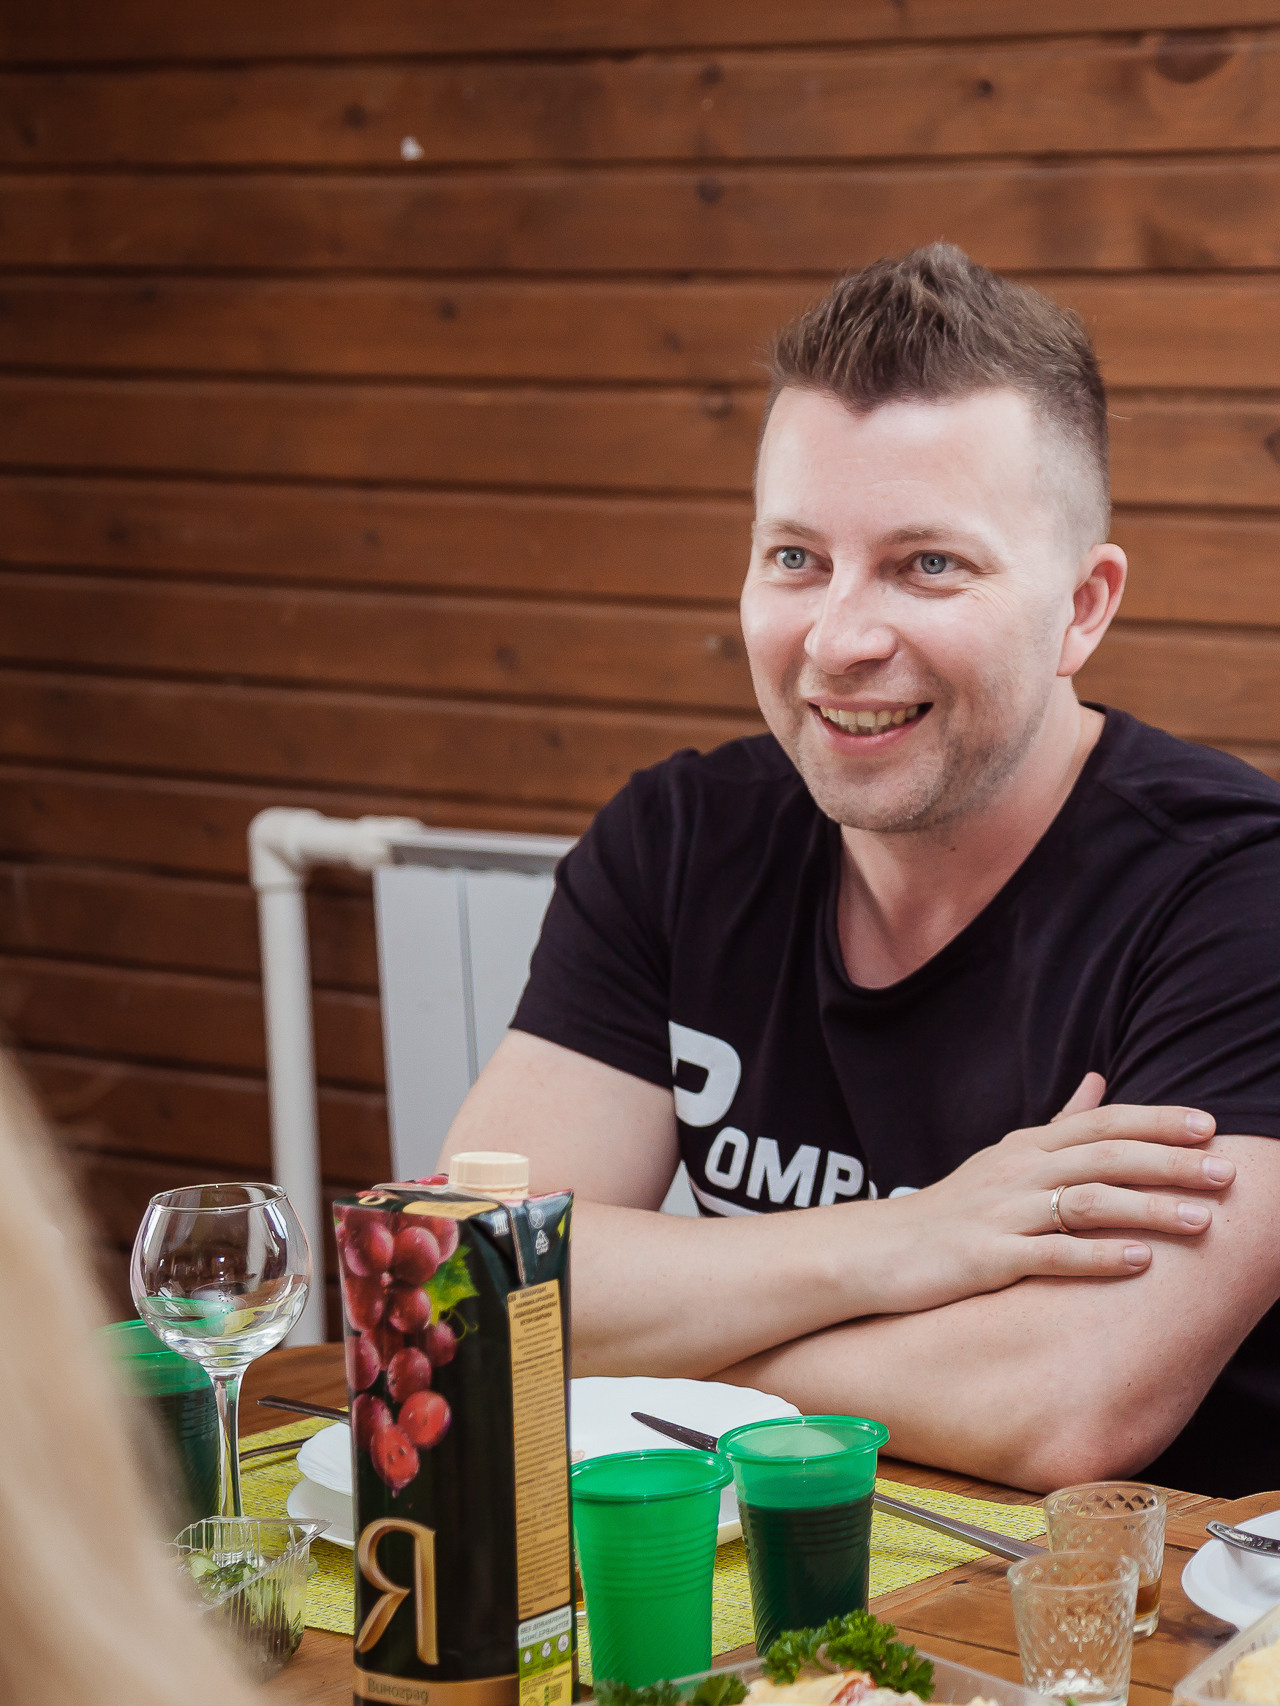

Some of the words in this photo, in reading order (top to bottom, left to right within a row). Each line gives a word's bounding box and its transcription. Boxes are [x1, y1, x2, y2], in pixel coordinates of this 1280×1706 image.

[668, 1019, 922, 1208] POMP
[354, 1517, 440, 1666] Я
[367, 1677, 430, 1705] Виноград
